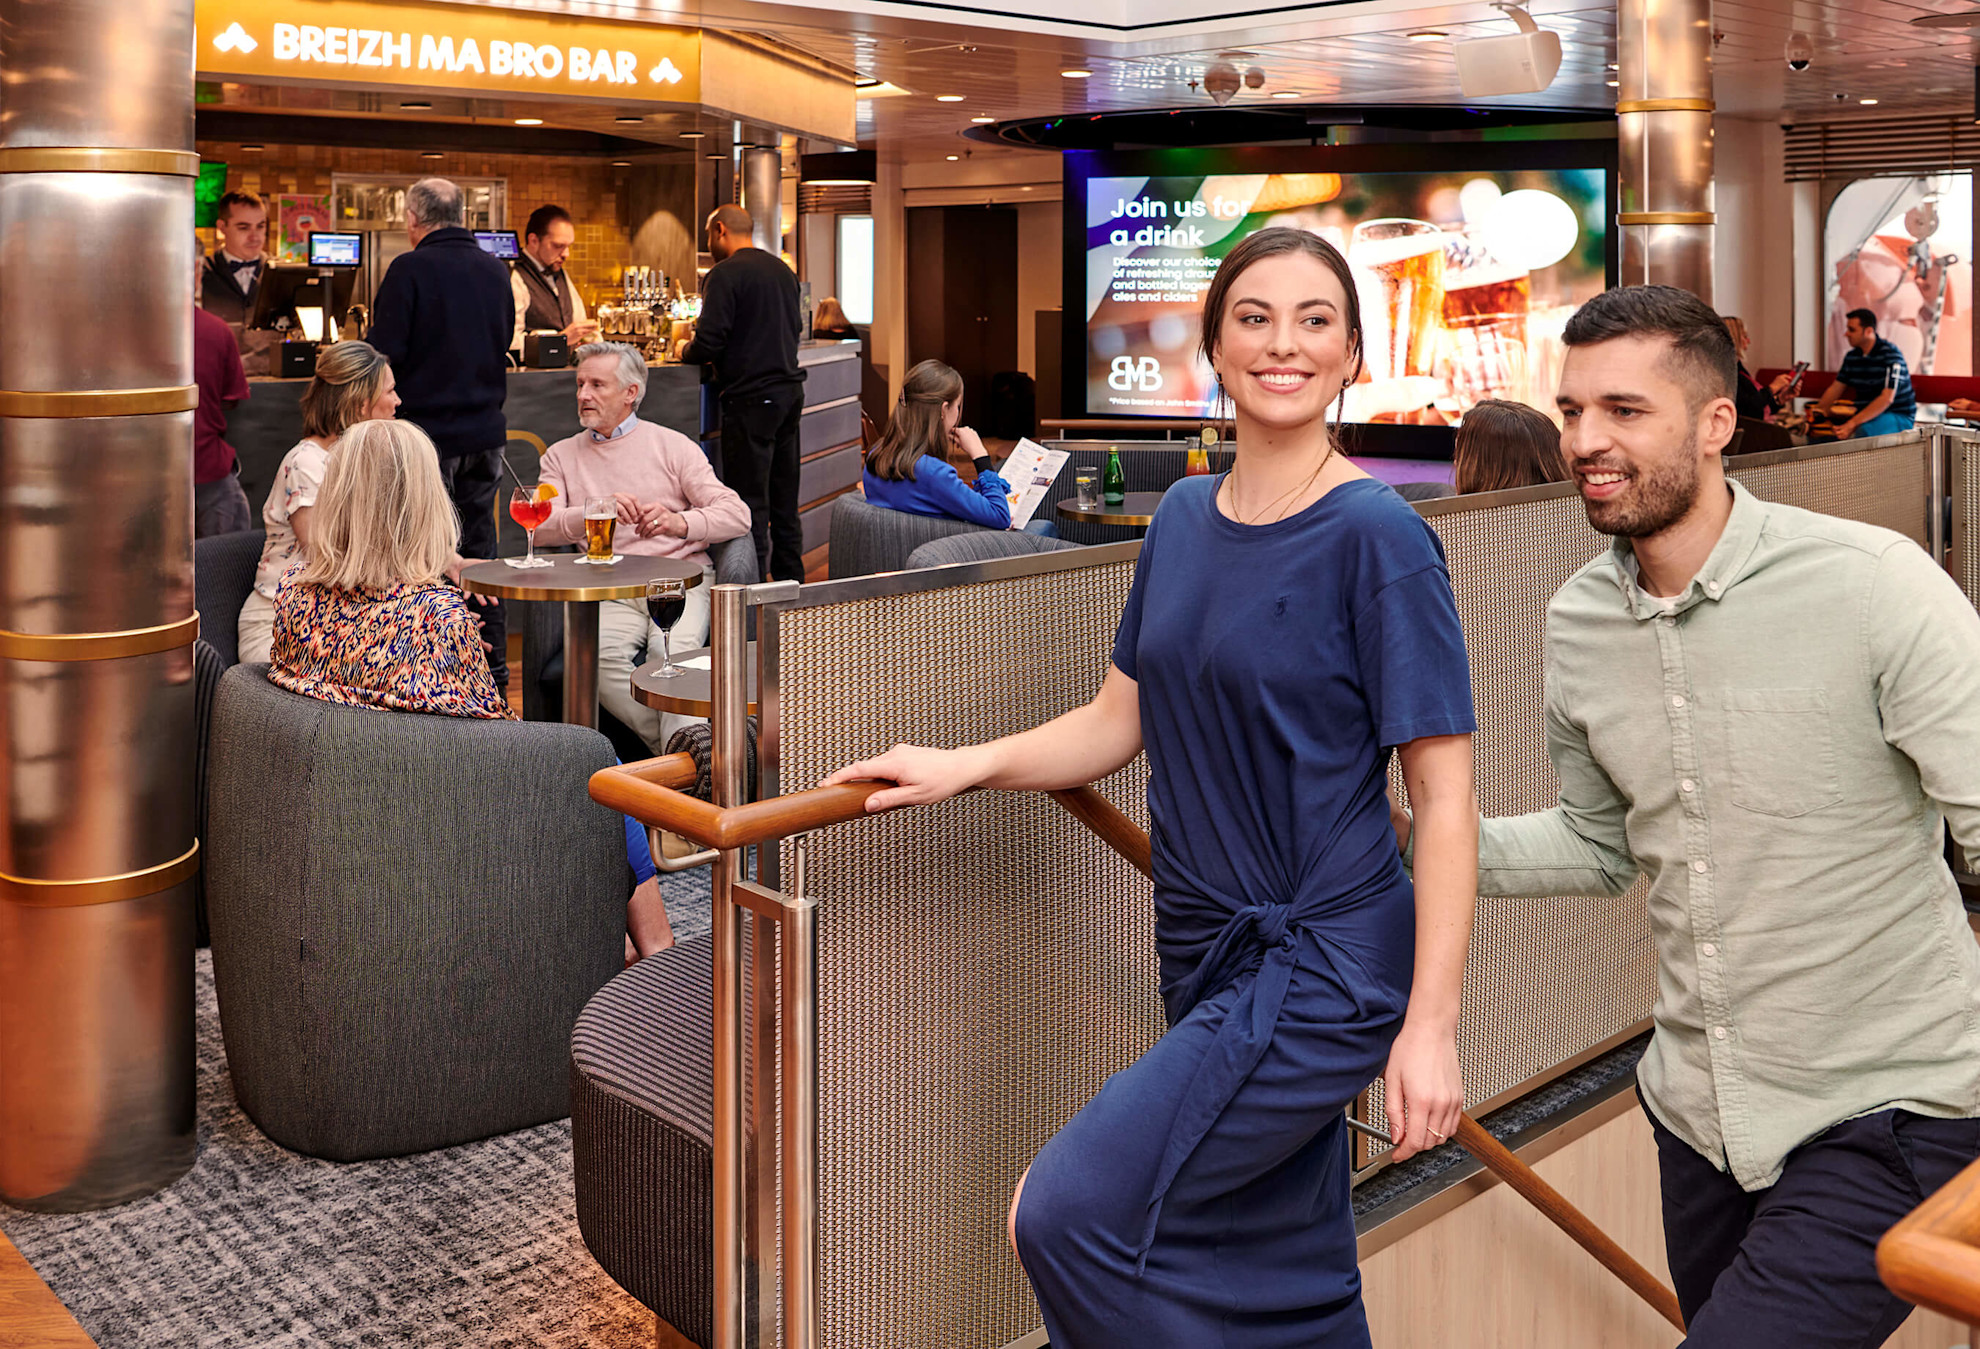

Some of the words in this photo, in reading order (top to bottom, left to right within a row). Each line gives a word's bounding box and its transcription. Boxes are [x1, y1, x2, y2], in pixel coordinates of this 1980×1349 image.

[273, 22, 411, 68] BREIZH
[418, 34, 485, 73] MA
[489, 40, 564, 78] BRO
[569, 46, 637, 84] BAR
[1110, 196, 1167, 217] Join
[1174, 200, 1206, 218] us
[1213, 196, 1251, 217] for
[1110, 229, 1128, 246] a
[1135, 225, 1205, 246] drink
[1113, 257, 1160, 266] Discover
[1162, 258, 1181, 267] our
[1184, 257, 1222, 267] choice
[1112, 268, 1124, 279] of
[1127, 269, 1182, 280] refreshing
[1112, 280, 1136, 291] and
[1137, 280, 1178, 291] bottled
[1179, 280, 1211, 292] lager
[1112, 292, 1137, 302] ales
[1138, 292, 1161, 302] and
[1162, 292, 1198, 302] ciders
